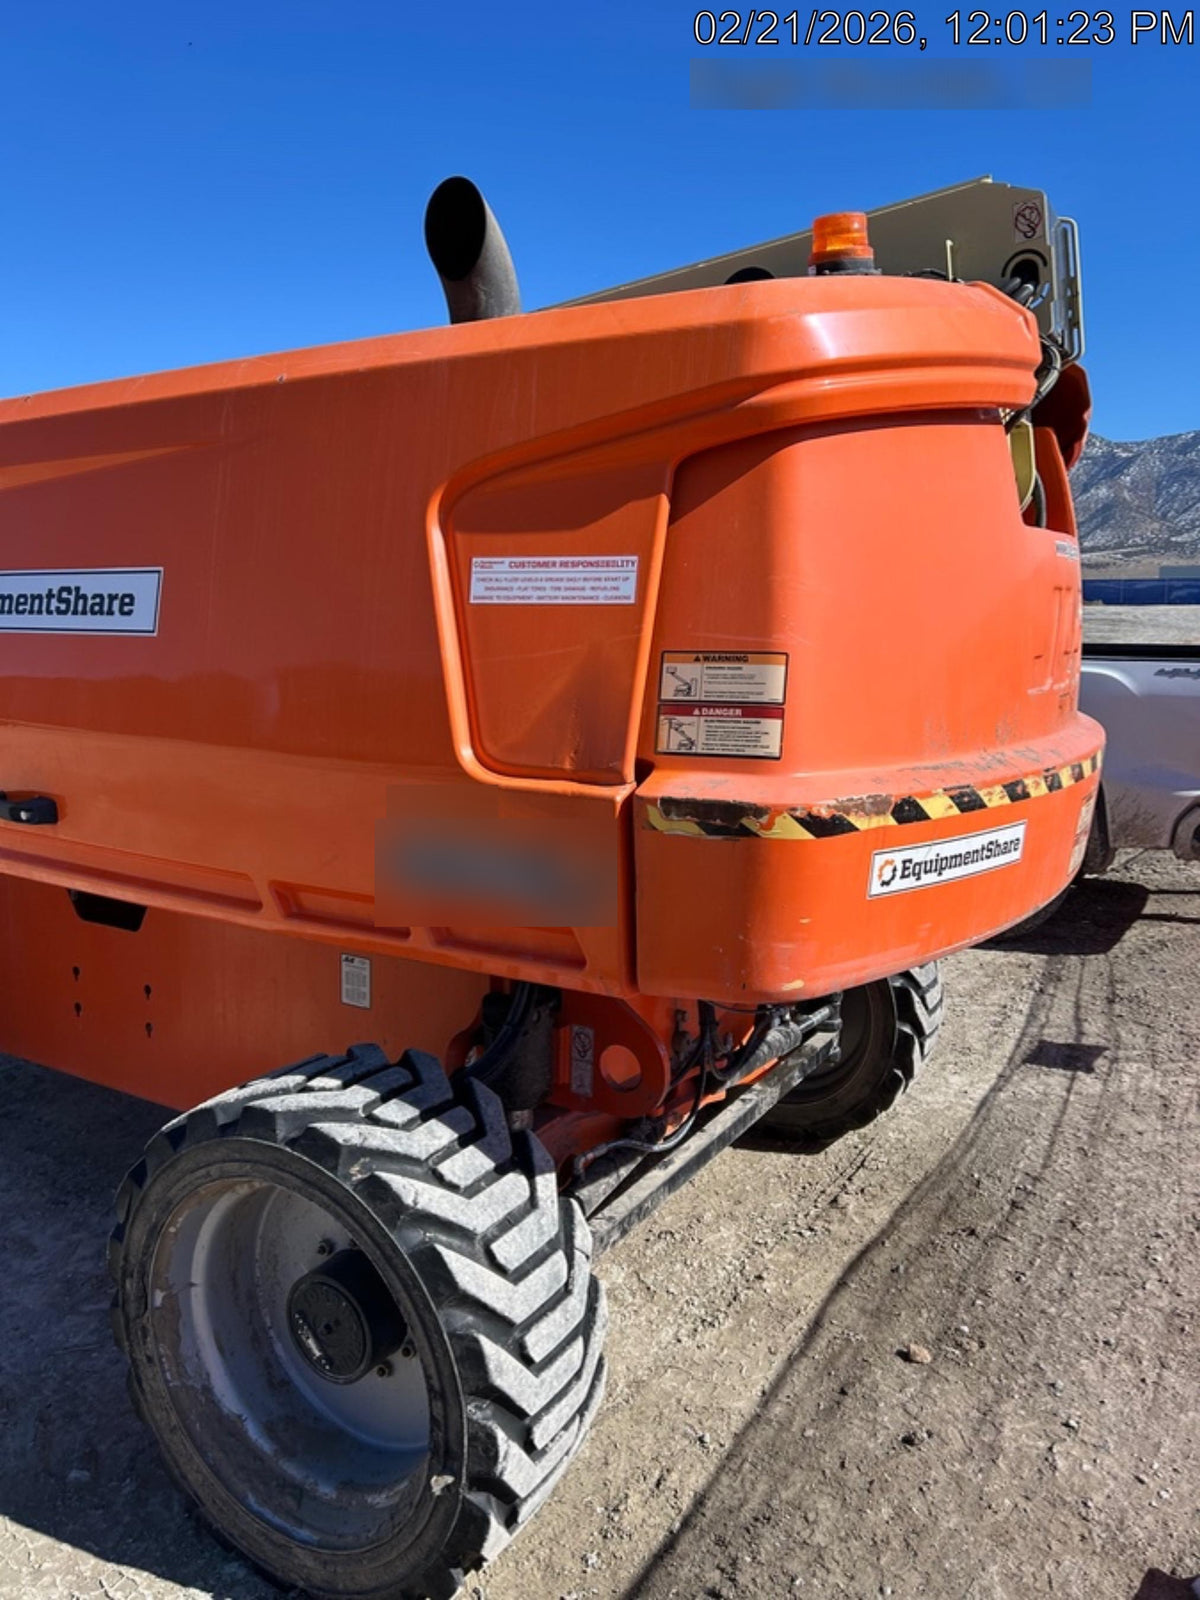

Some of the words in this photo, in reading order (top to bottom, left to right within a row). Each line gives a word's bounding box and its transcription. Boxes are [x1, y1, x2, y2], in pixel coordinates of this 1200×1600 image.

[508, 560, 557, 569] CUSTOMER
[559, 559, 637, 569] RESPONSIBILITY
[703, 655, 749, 663] WARNING
[701, 708, 742, 716] DANGER
[899, 837, 1021, 881] EquipmentShare
